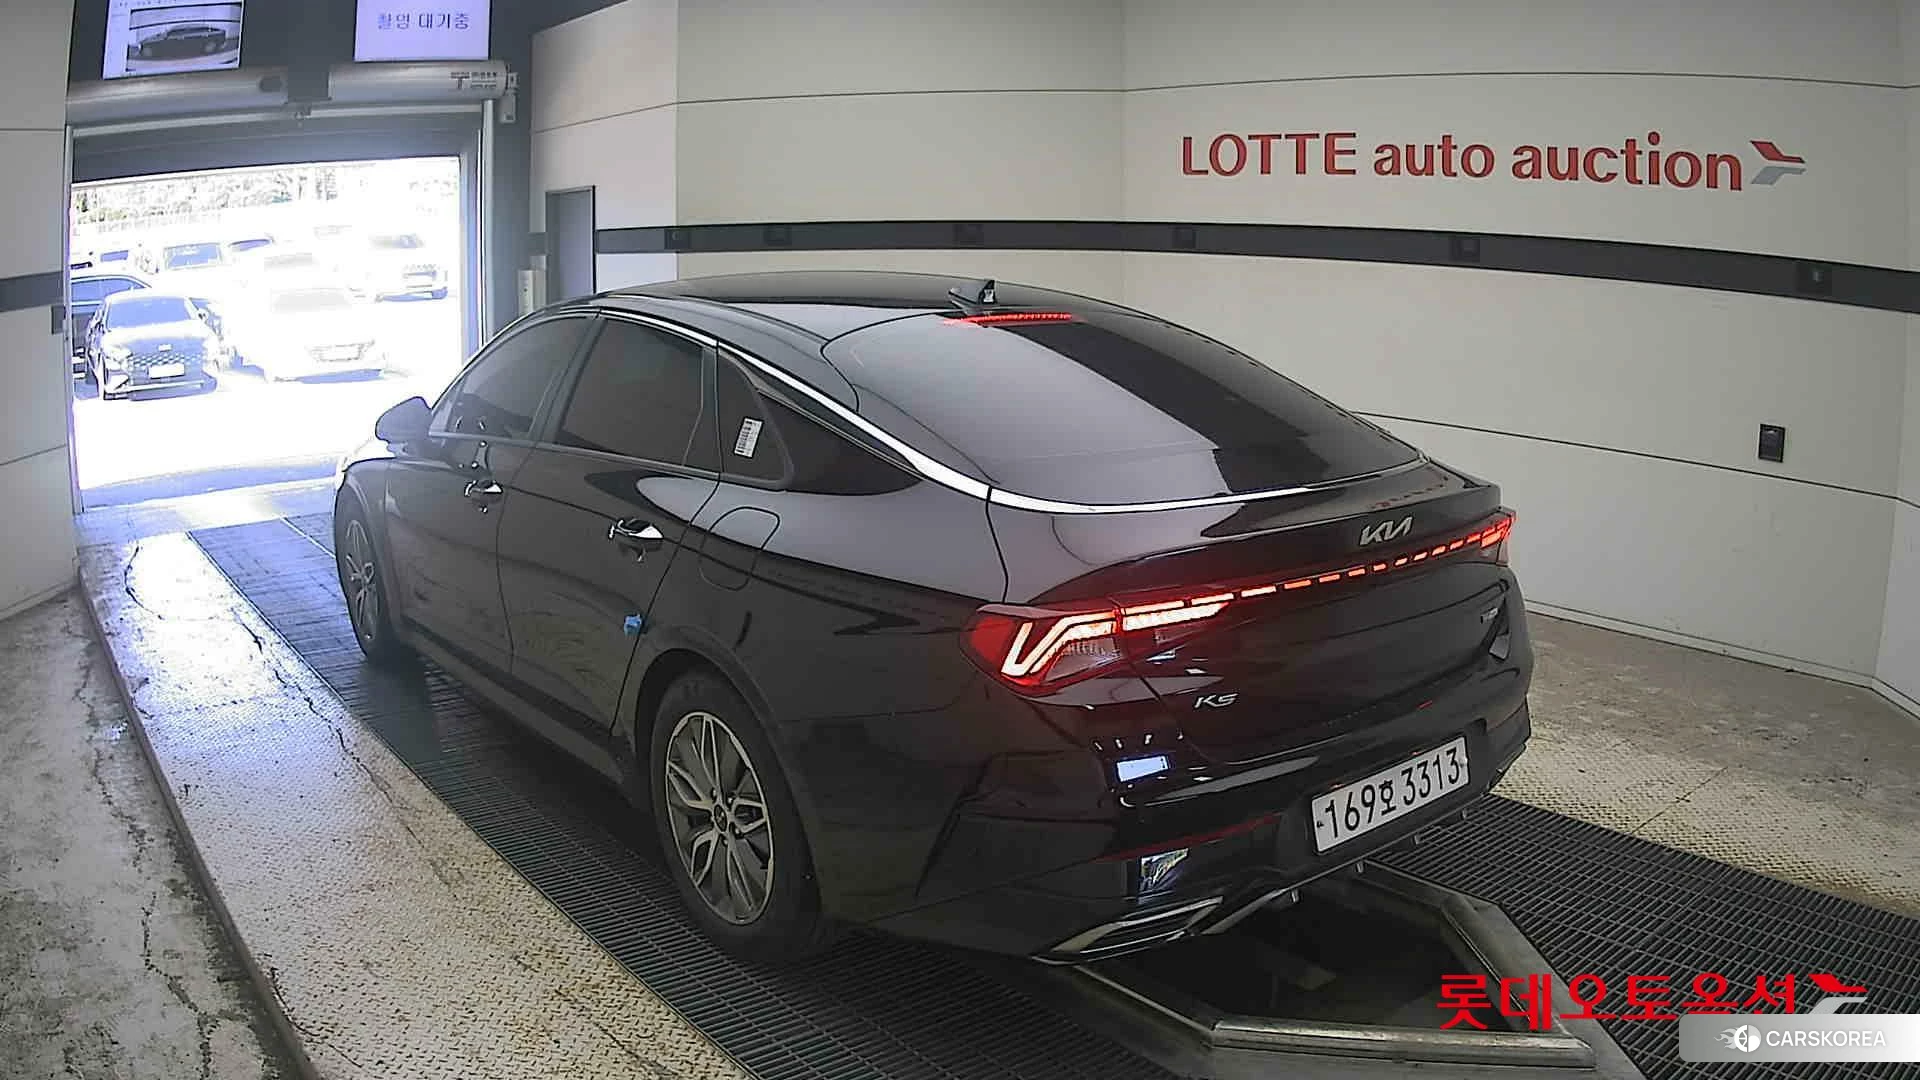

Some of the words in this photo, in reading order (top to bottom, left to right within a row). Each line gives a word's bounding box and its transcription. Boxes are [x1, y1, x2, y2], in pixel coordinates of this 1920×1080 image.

[418, 13, 469, 30] 대기중
[1182, 132, 1357, 177] LOTTE
[1374, 135, 1496, 177] auto
[1512, 132, 1743, 191] auction
[1194, 693, 1239, 709] K5
[1401, 747, 1460, 806] 3313
